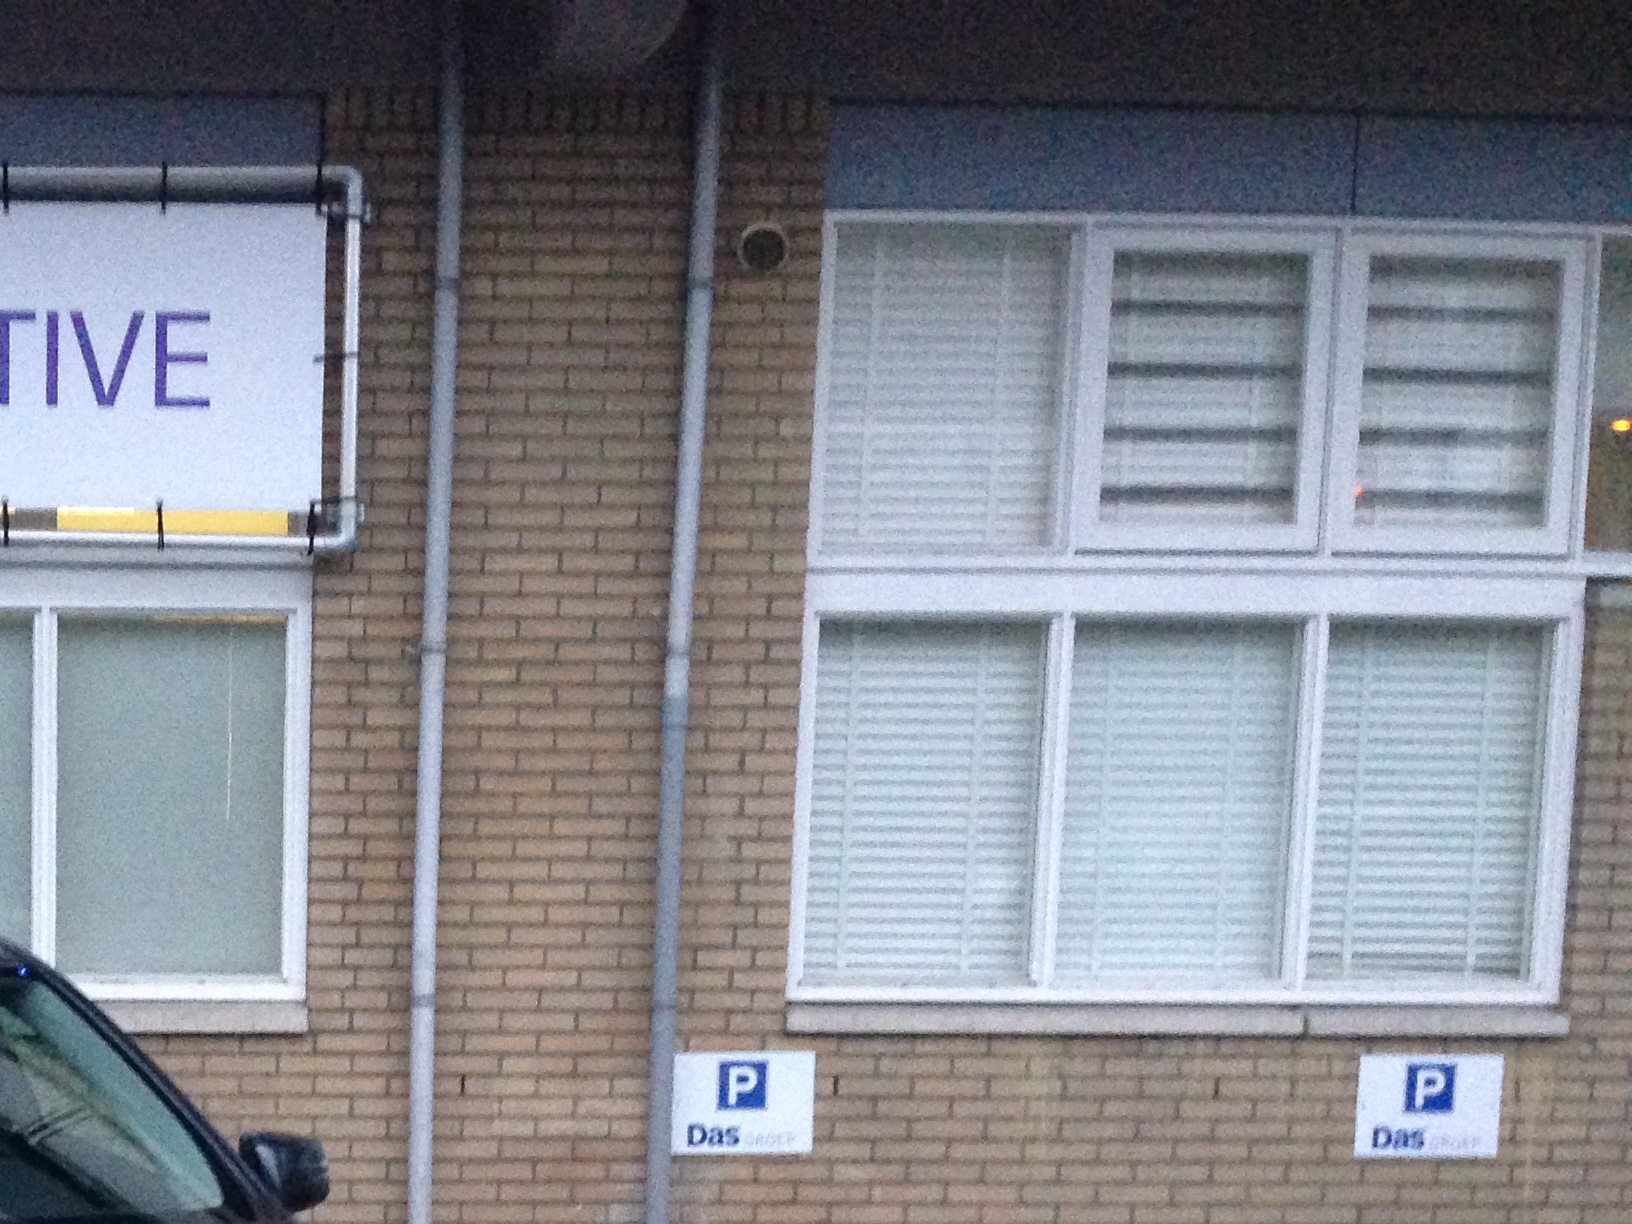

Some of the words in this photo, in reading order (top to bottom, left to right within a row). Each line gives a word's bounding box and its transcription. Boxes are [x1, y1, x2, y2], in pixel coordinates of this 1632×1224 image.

[727, 1064, 759, 1107] P
[1414, 1067, 1446, 1109] P
[686, 1122, 740, 1148] Das
[1371, 1125, 1425, 1151] Das
